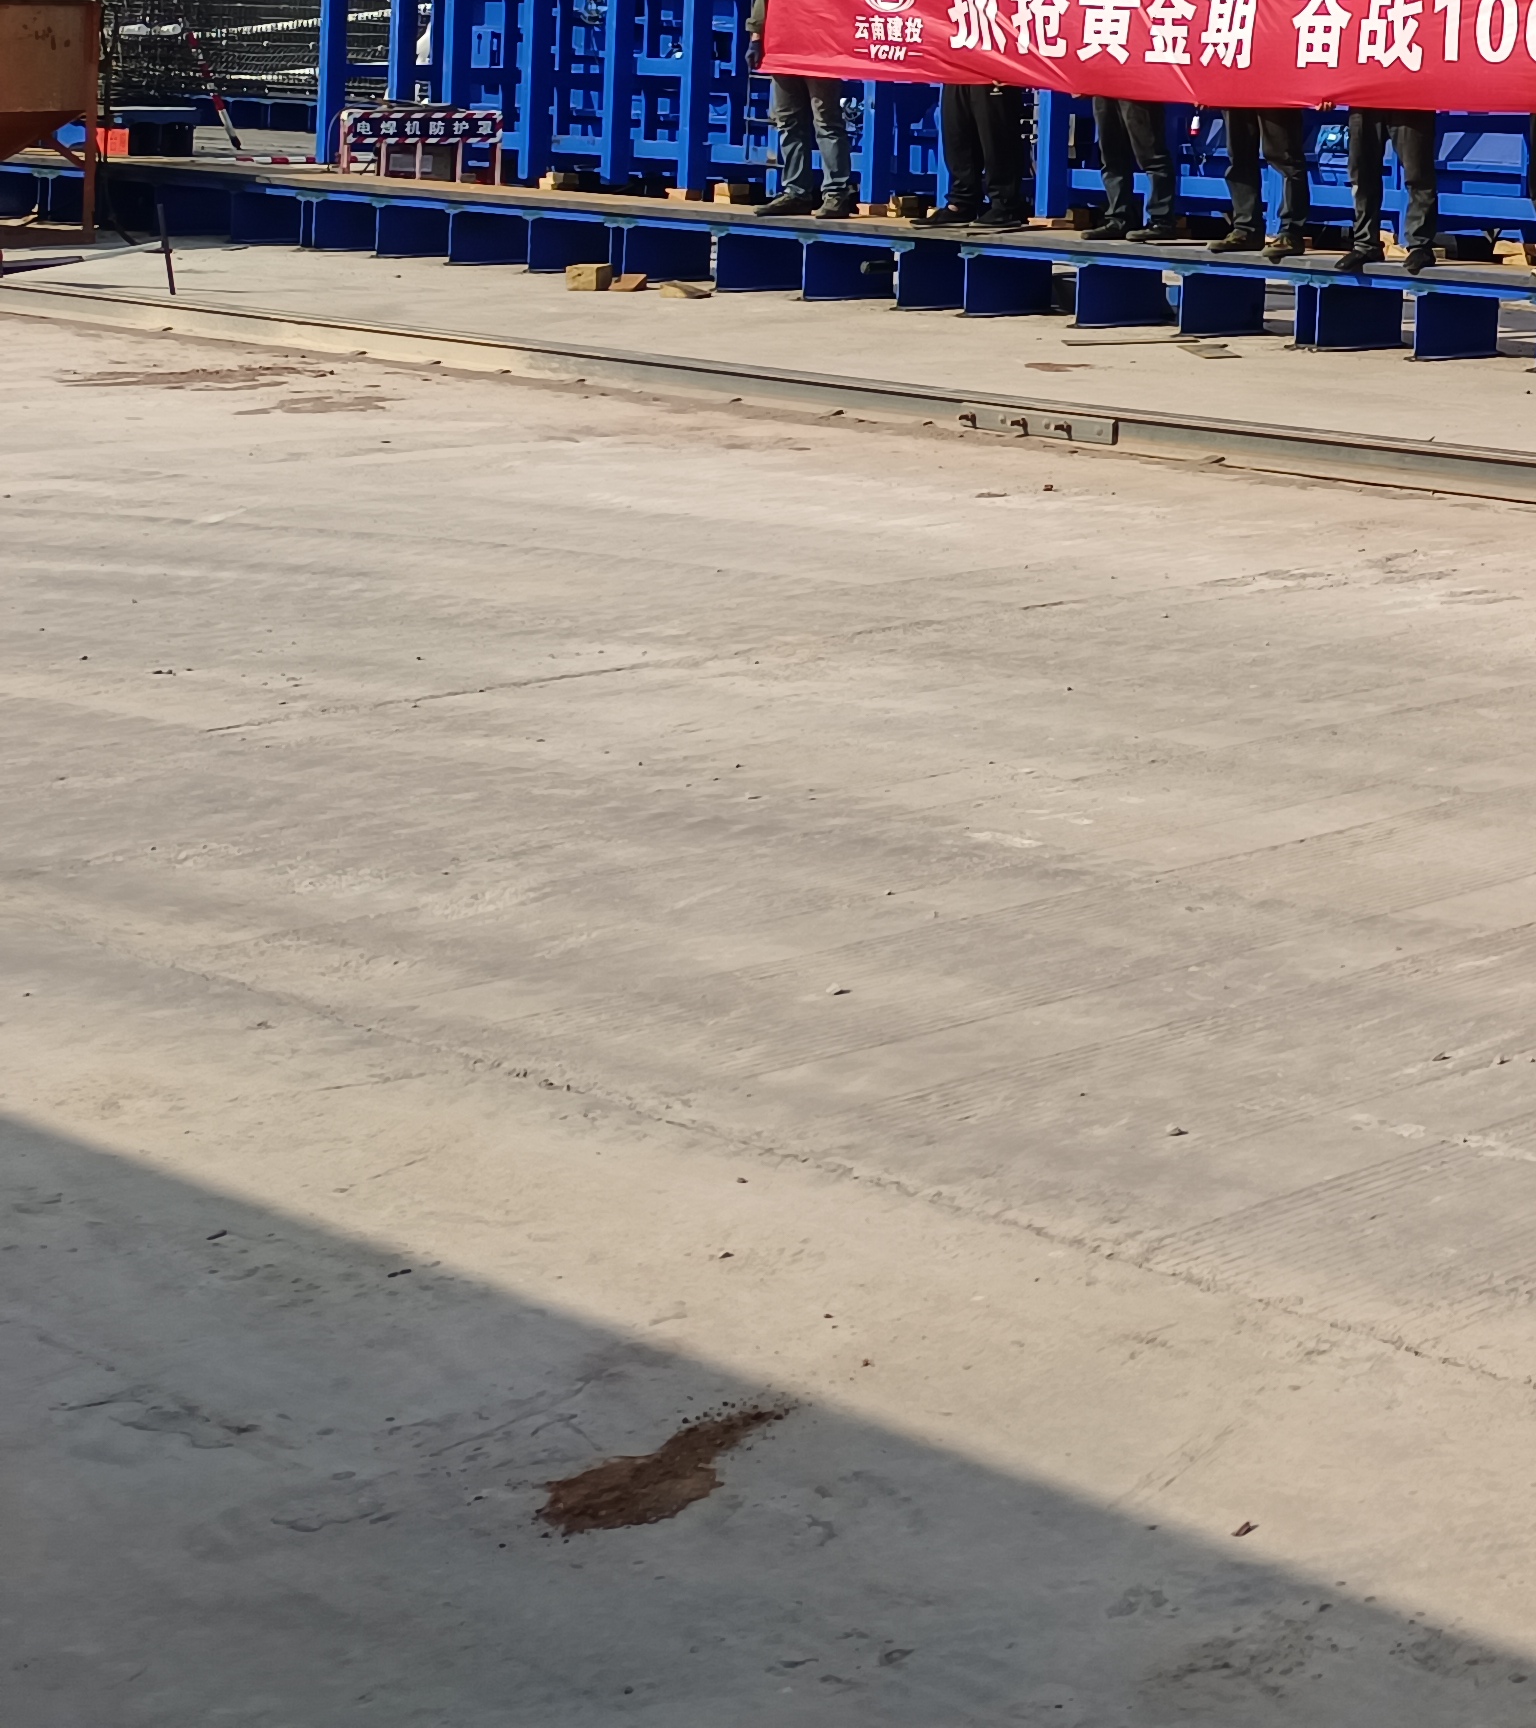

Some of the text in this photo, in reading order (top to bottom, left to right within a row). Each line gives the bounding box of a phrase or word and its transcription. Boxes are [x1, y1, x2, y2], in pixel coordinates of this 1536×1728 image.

[854, 14, 924, 43] 云南建投
[869, 43, 907, 61] YCIH
[356, 119, 493, 136] 电焊机防护罩
